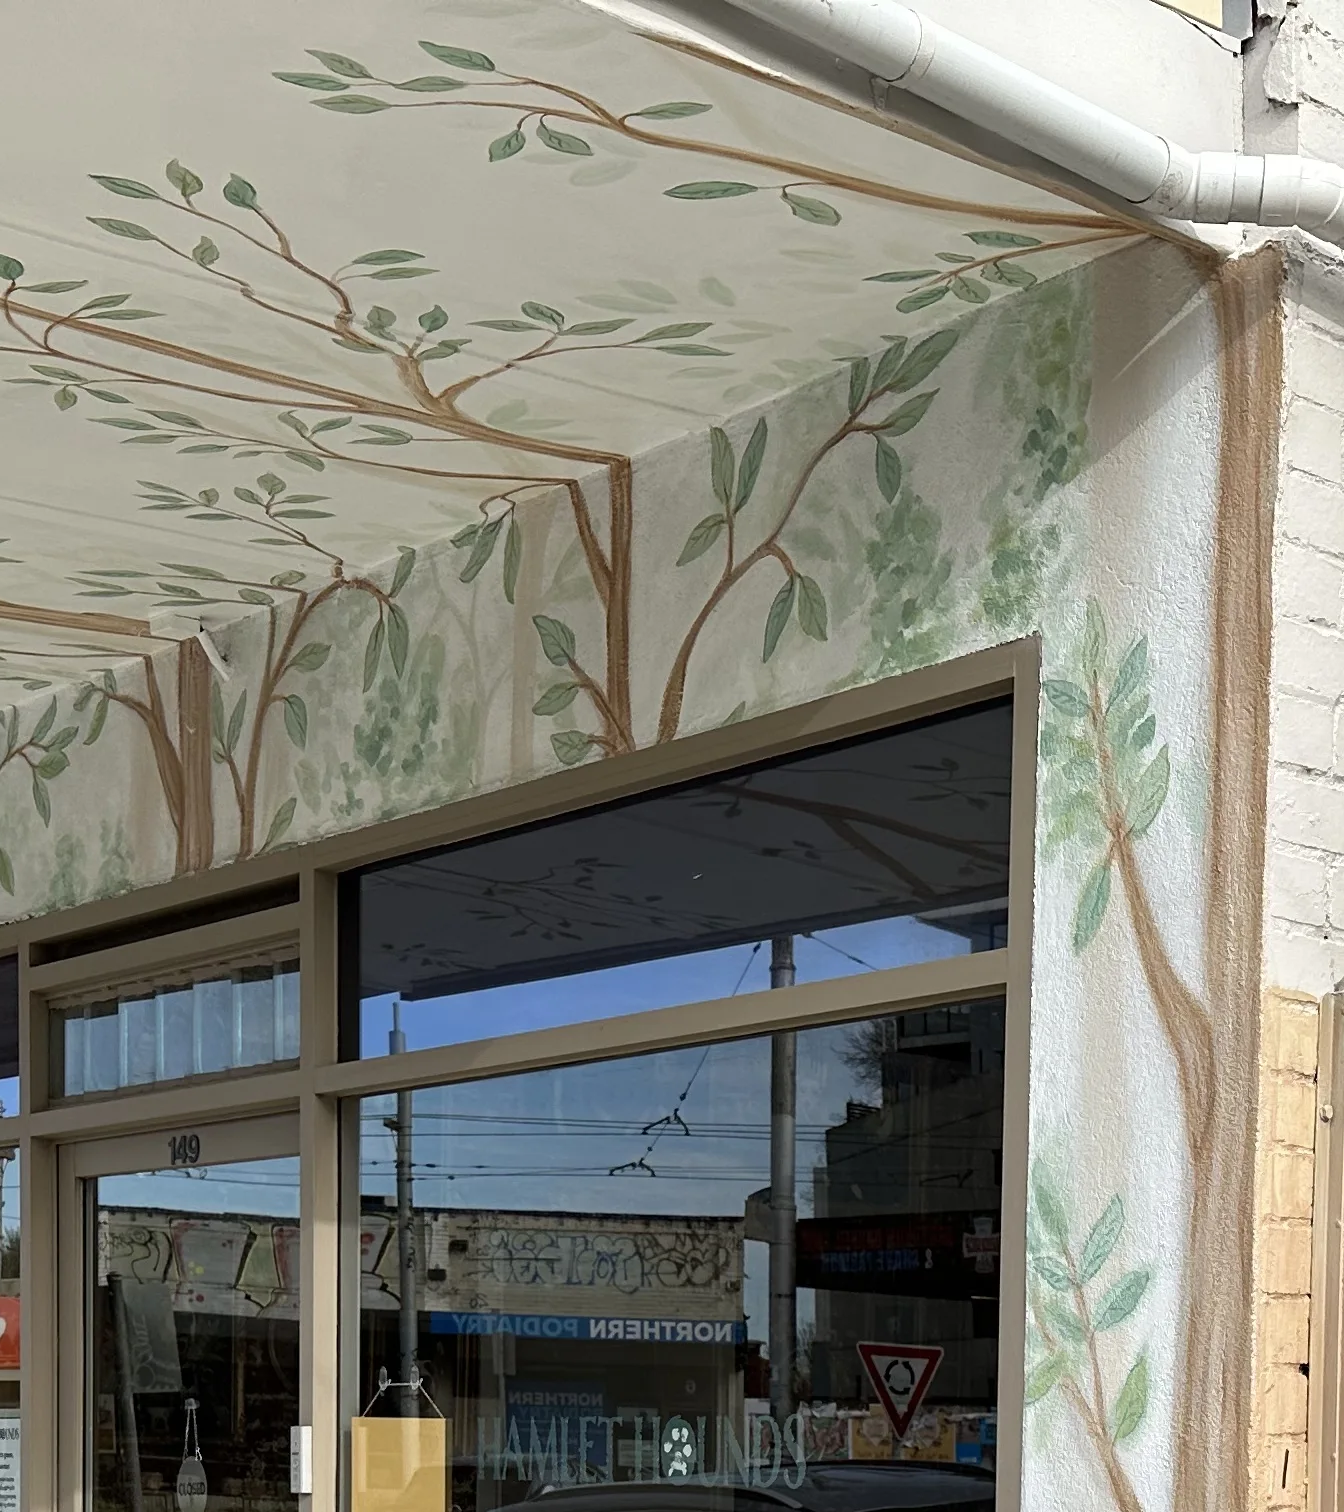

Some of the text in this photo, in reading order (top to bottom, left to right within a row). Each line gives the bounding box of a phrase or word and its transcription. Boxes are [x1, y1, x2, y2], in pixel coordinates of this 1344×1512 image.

[167, 1133, 201, 1166] 149
[476, 1412, 807, 1491] HAMLET HOUNDS
[178, 1481, 206, 1497] CLOSED
